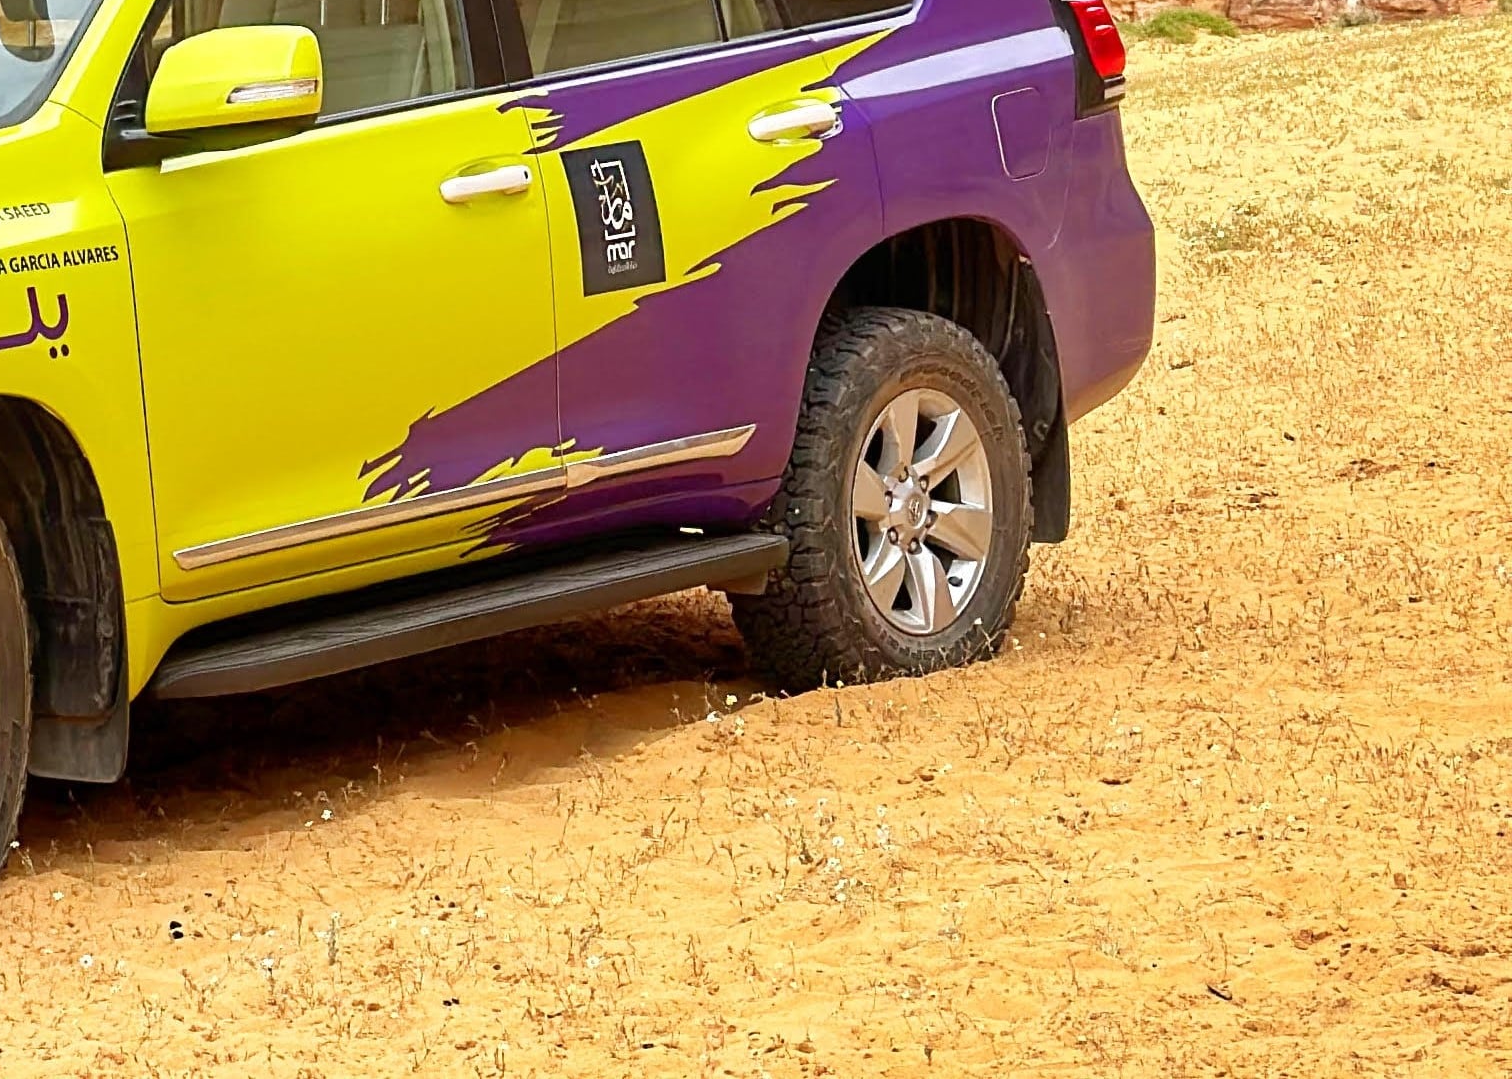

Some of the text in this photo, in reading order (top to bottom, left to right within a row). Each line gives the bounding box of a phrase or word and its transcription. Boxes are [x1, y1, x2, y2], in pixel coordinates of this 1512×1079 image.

[3, 202, 51, 220] SAEED
[9, 252, 61, 274] GARCIA
[62, 245, 120, 268] ALVARES
